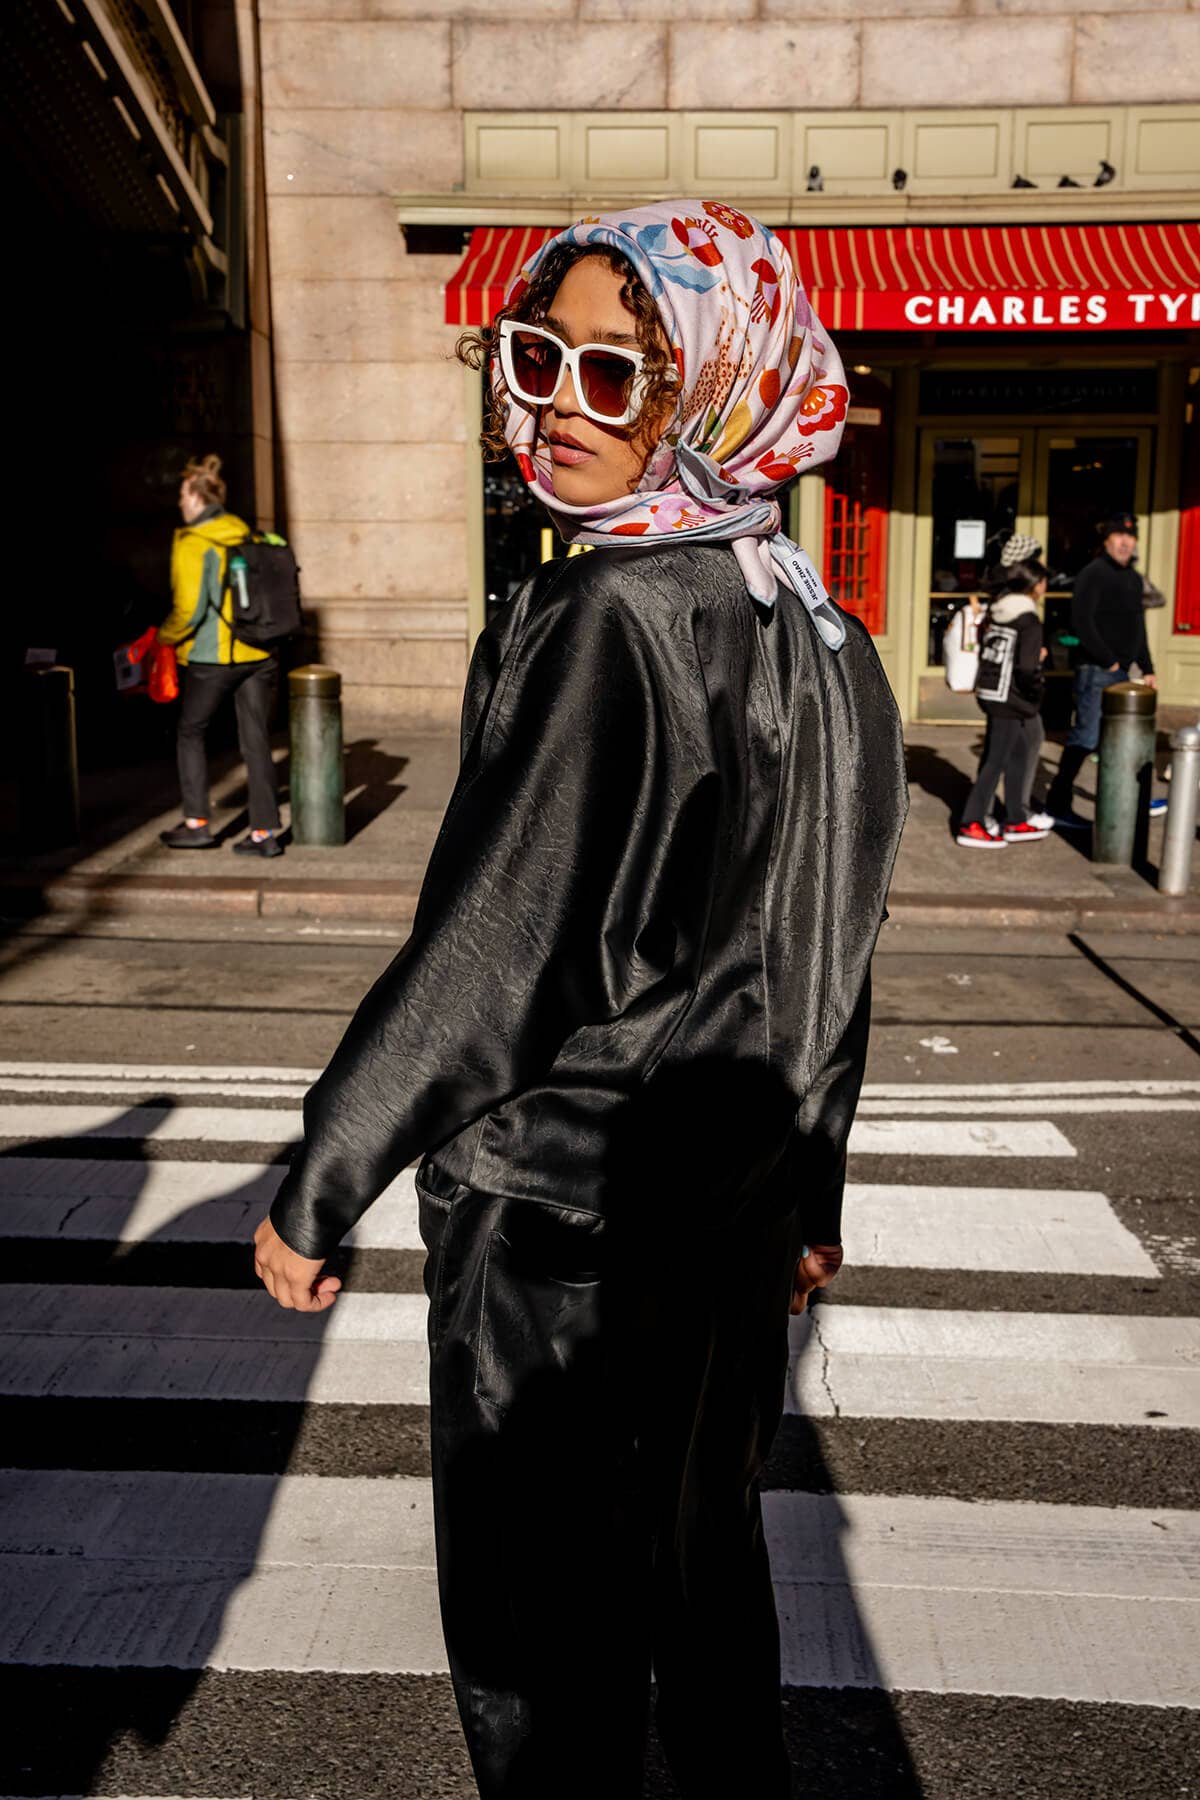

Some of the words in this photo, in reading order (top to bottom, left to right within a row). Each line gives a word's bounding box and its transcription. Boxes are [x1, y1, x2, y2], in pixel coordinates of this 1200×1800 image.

[904, 295, 1108, 325] CHARLES
[792, 560, 806, 579] ZHAO
[803, 579, 818, 600] JESSIE
